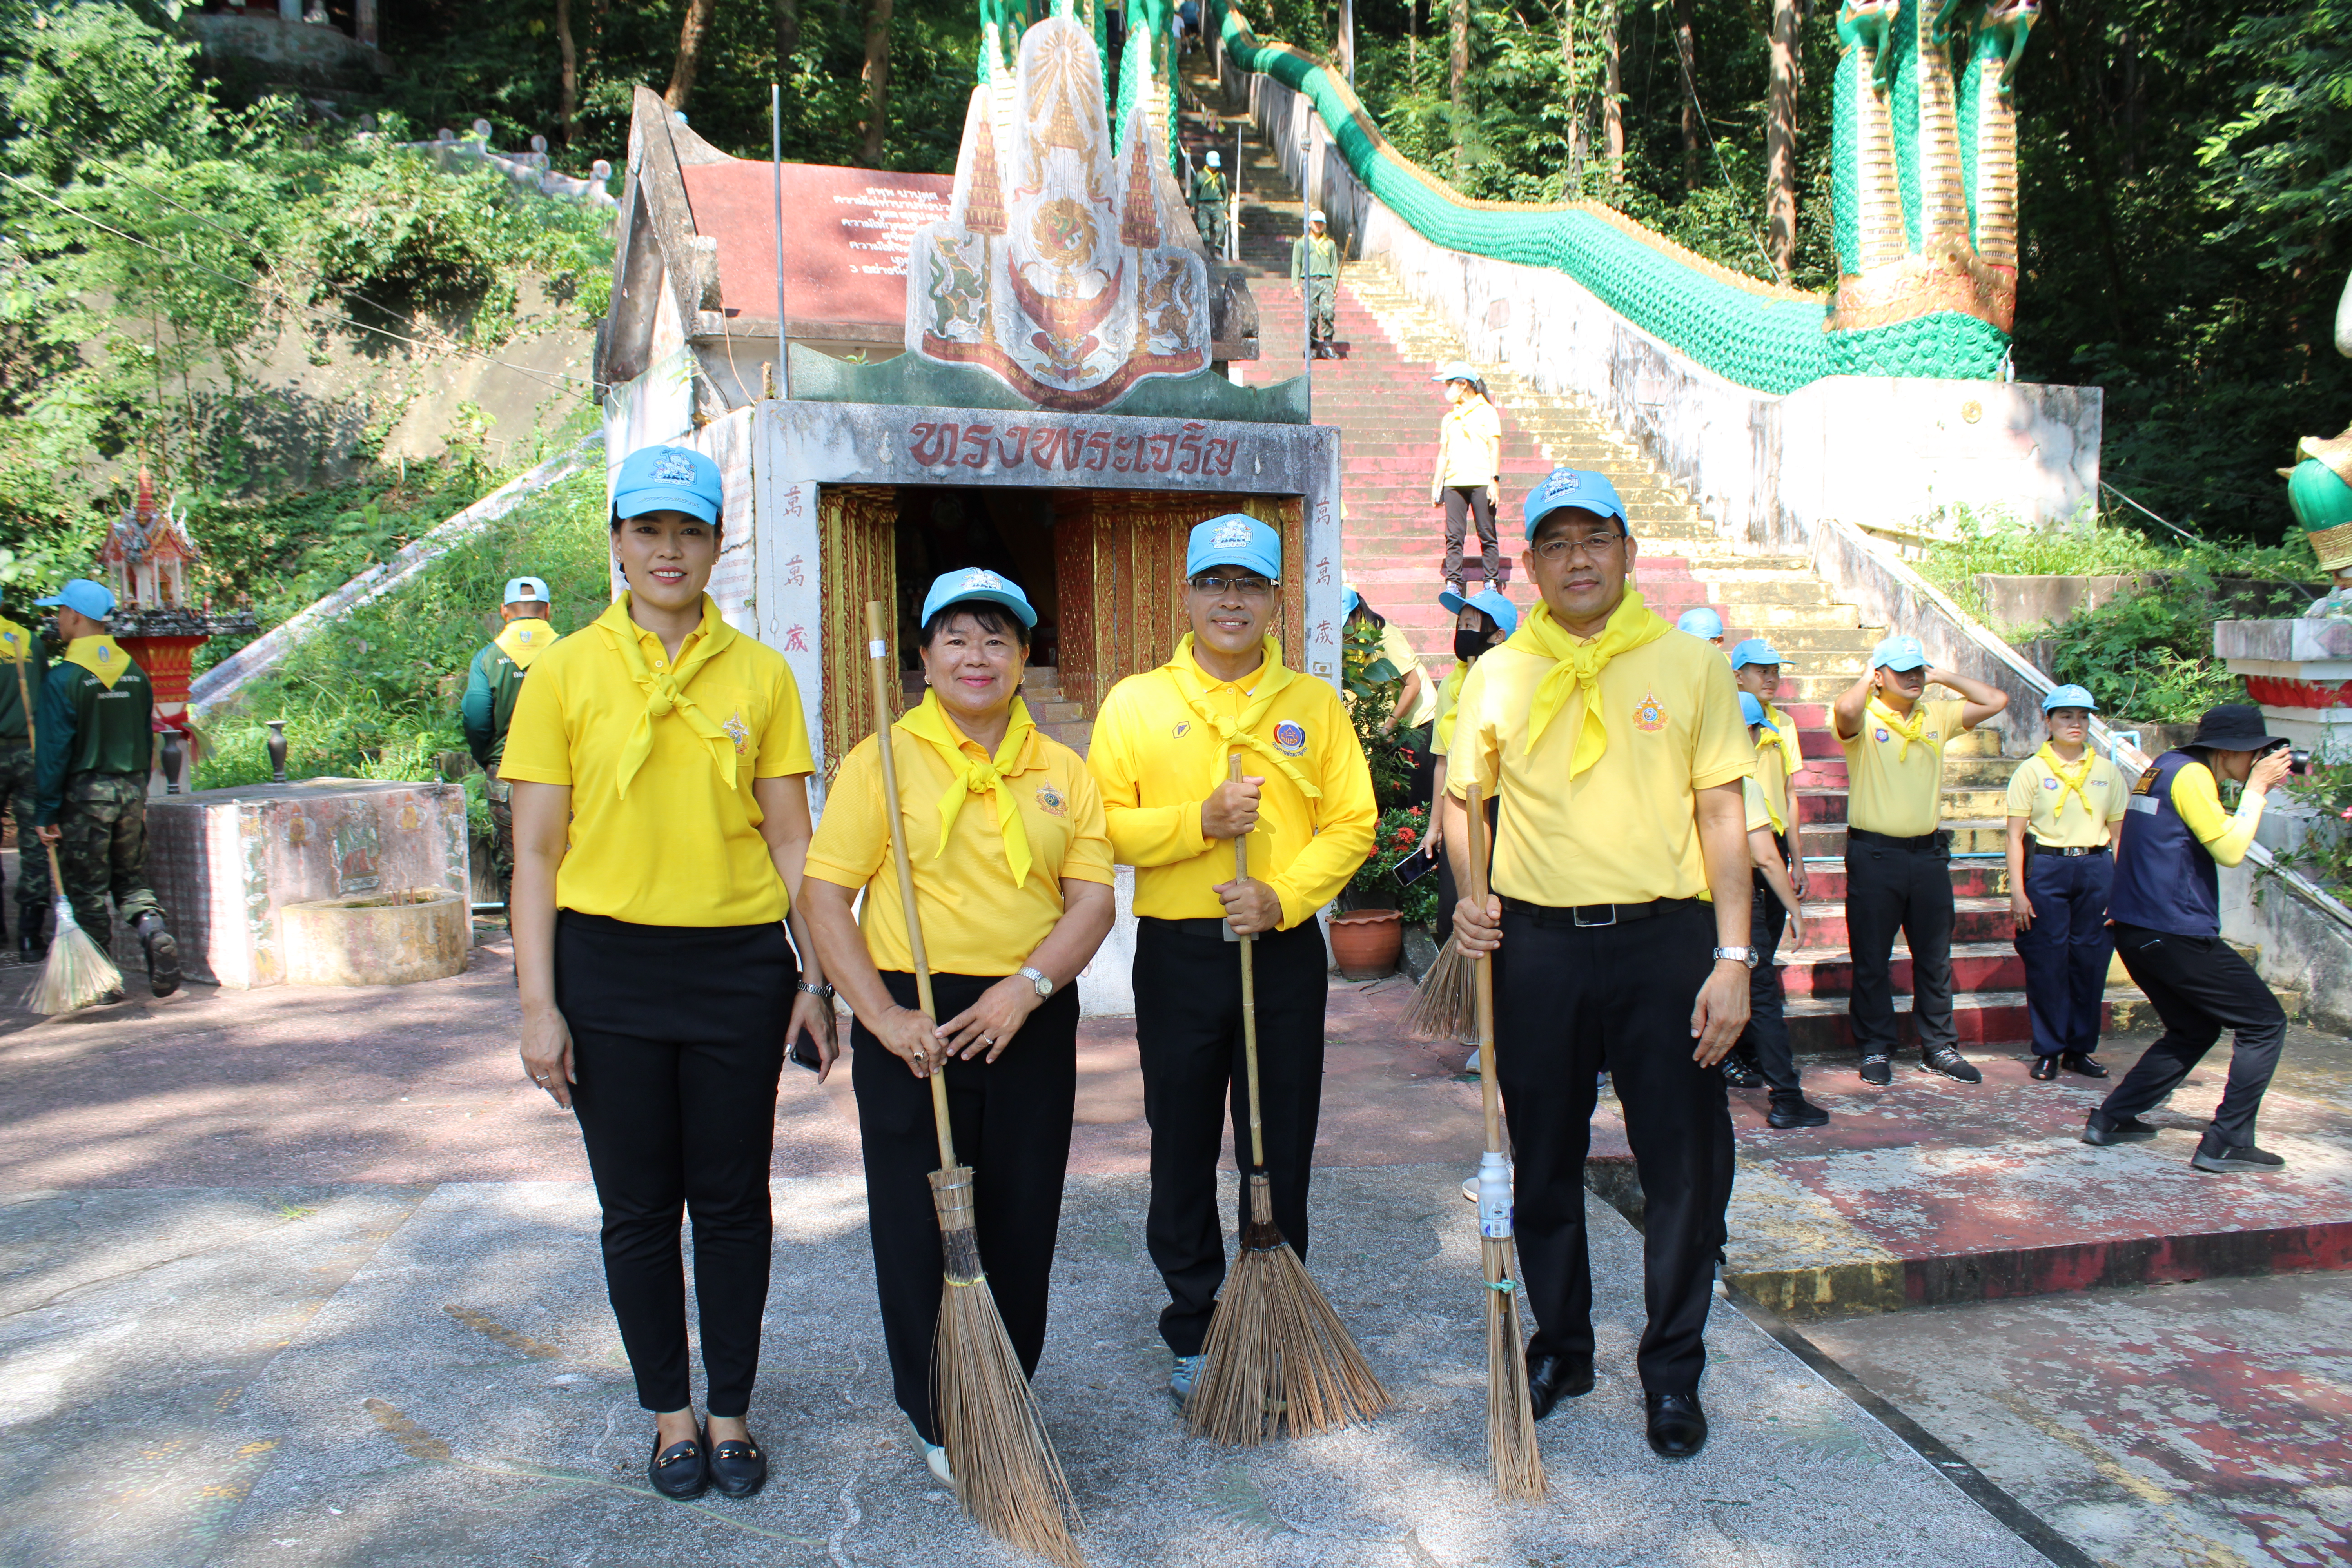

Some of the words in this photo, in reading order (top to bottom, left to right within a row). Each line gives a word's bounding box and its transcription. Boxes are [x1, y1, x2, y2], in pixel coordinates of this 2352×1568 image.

[908, 422, 1238, 476] ทรงพระเจริญ
